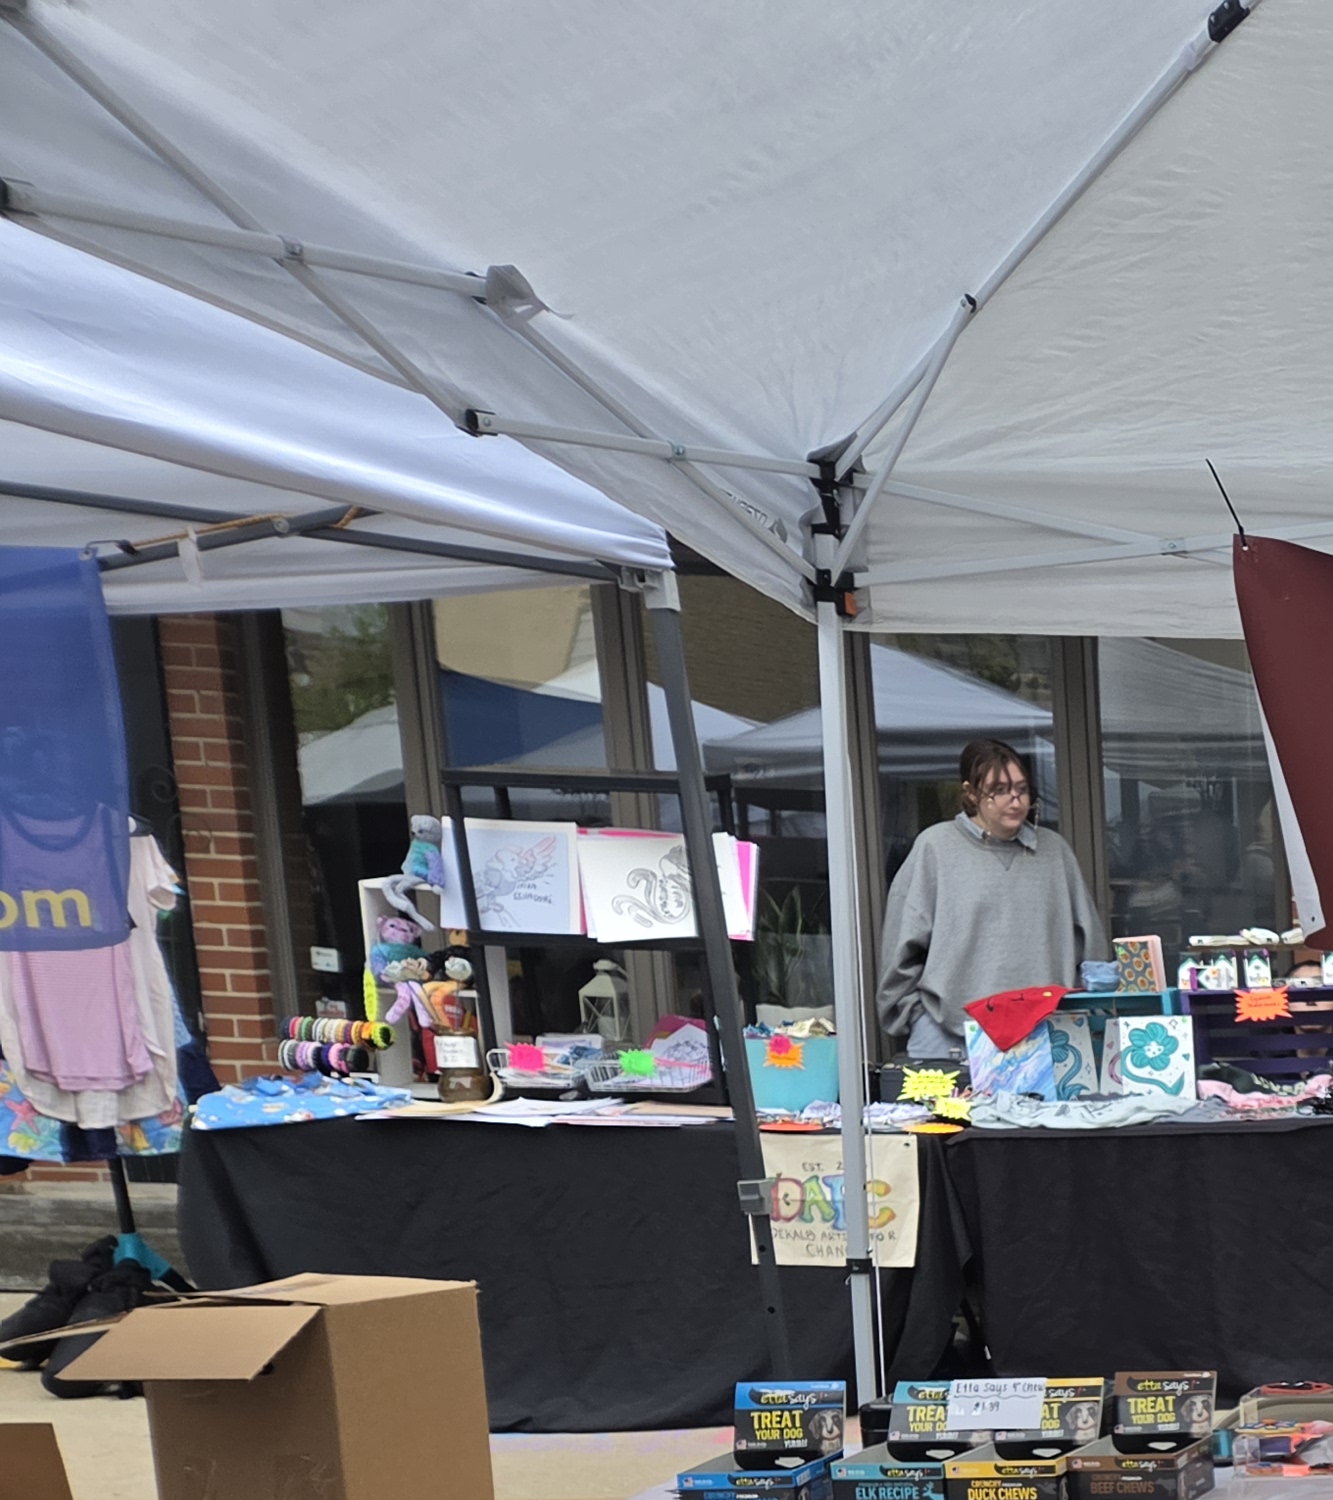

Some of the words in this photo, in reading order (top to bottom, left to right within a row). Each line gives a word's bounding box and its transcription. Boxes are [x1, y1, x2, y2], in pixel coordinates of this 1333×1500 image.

[1127, 1396, 1176, 1414] TREAT
[751, 1410, 803, 1429] TREAT
[1041, 1420, 1061, 1430] DOG
[1132, 1414, 1154, 1424] YOUR
[1157, 1413, 1176, 1423] DOG
[909, 1422, 933, 1432] YOUR
[755, 1429, 780, 1440] YOUR
[784, 1428, 803, 1439] DOG
[855, 1487, 876, 1500] ELK
[879, 1486, 919, 1500] RECIPE
[968, 1488, 996, 1500] DUCK
[999, 1487, 1037, 1500] CHEWS
[1091, 1482, 1115, 1494] BEEF
[1117, 1481, 1154, 1494] CHEWS
